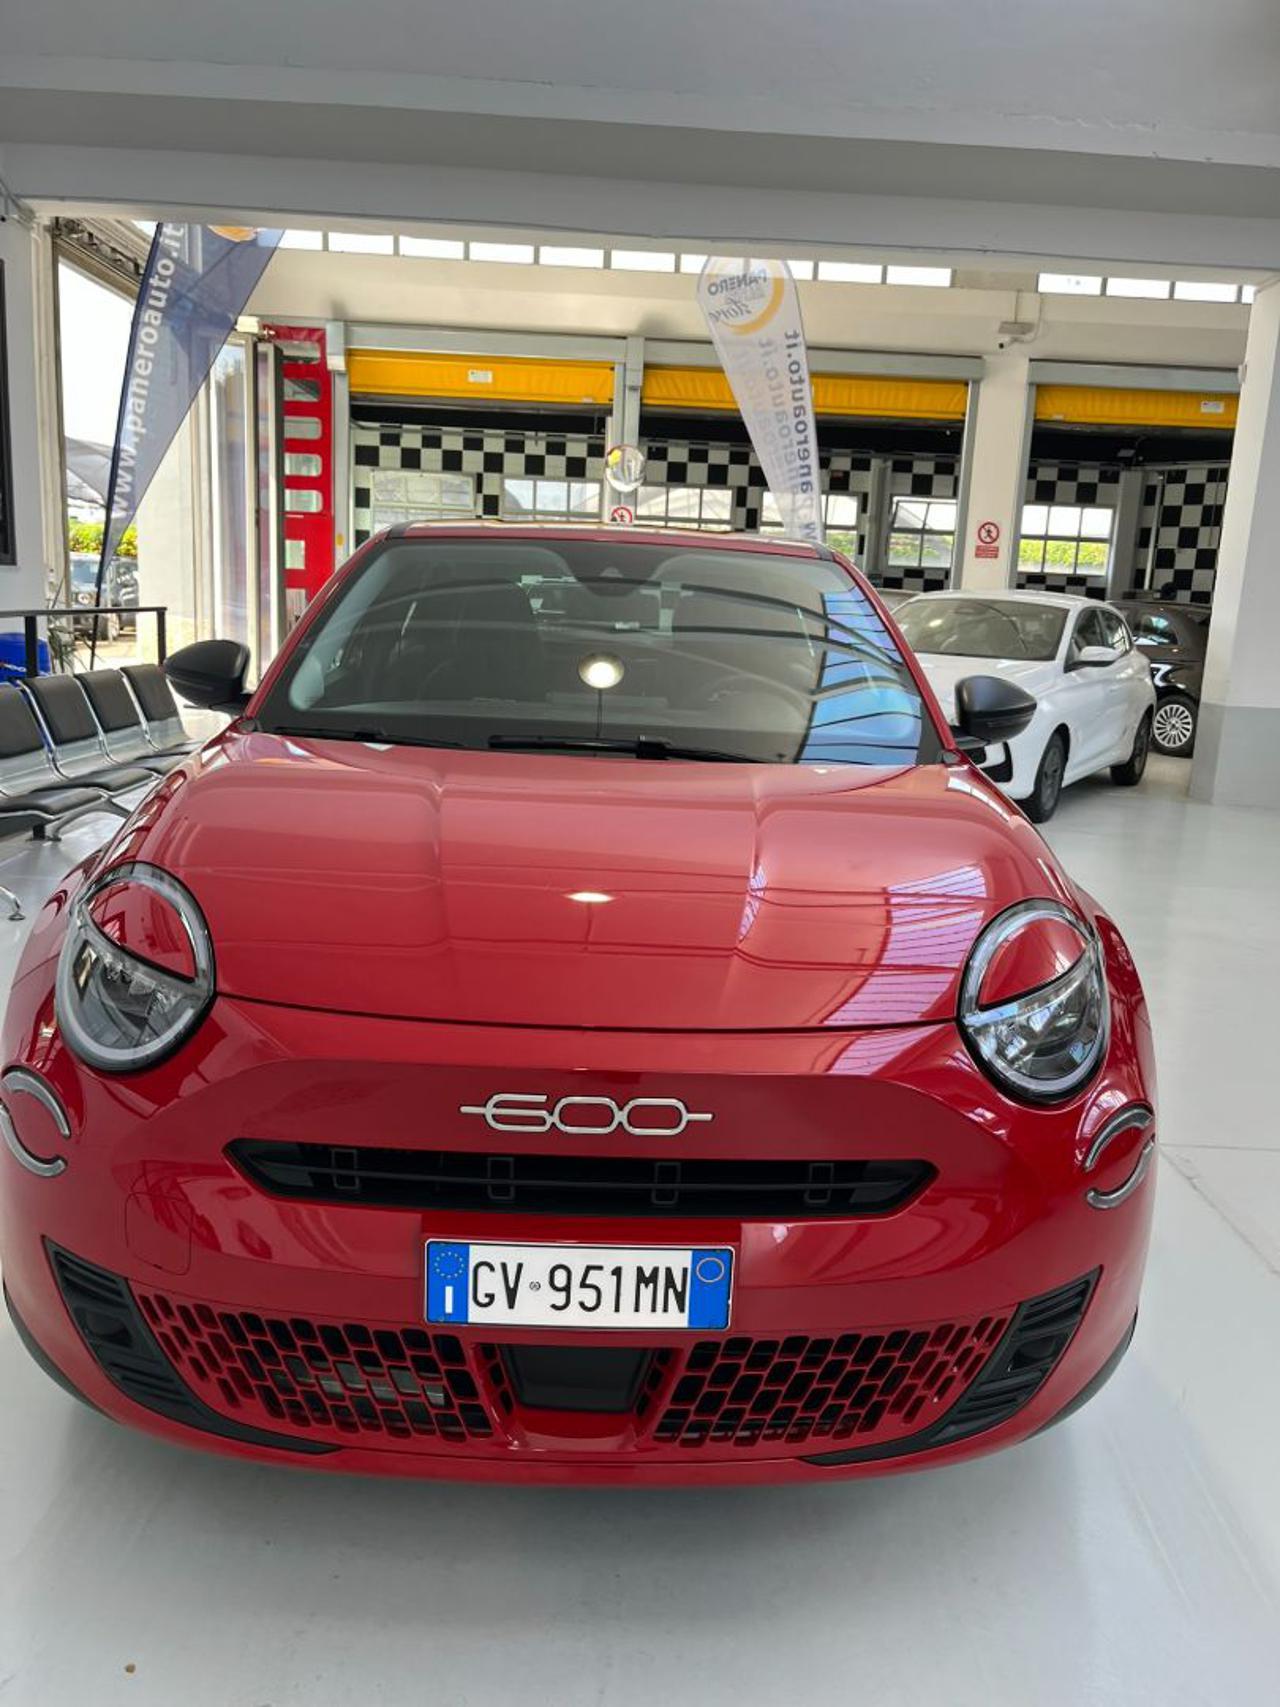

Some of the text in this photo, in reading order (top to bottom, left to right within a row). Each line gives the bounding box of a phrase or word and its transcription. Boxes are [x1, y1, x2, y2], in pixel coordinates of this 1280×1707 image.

[111, 223, 184, 518] www.paneroauto.it
[460, 1092, 713, 1136] 600
[472, 1261, 524, 1310] GV
[548, 1263, 689, 1314] 951MN
